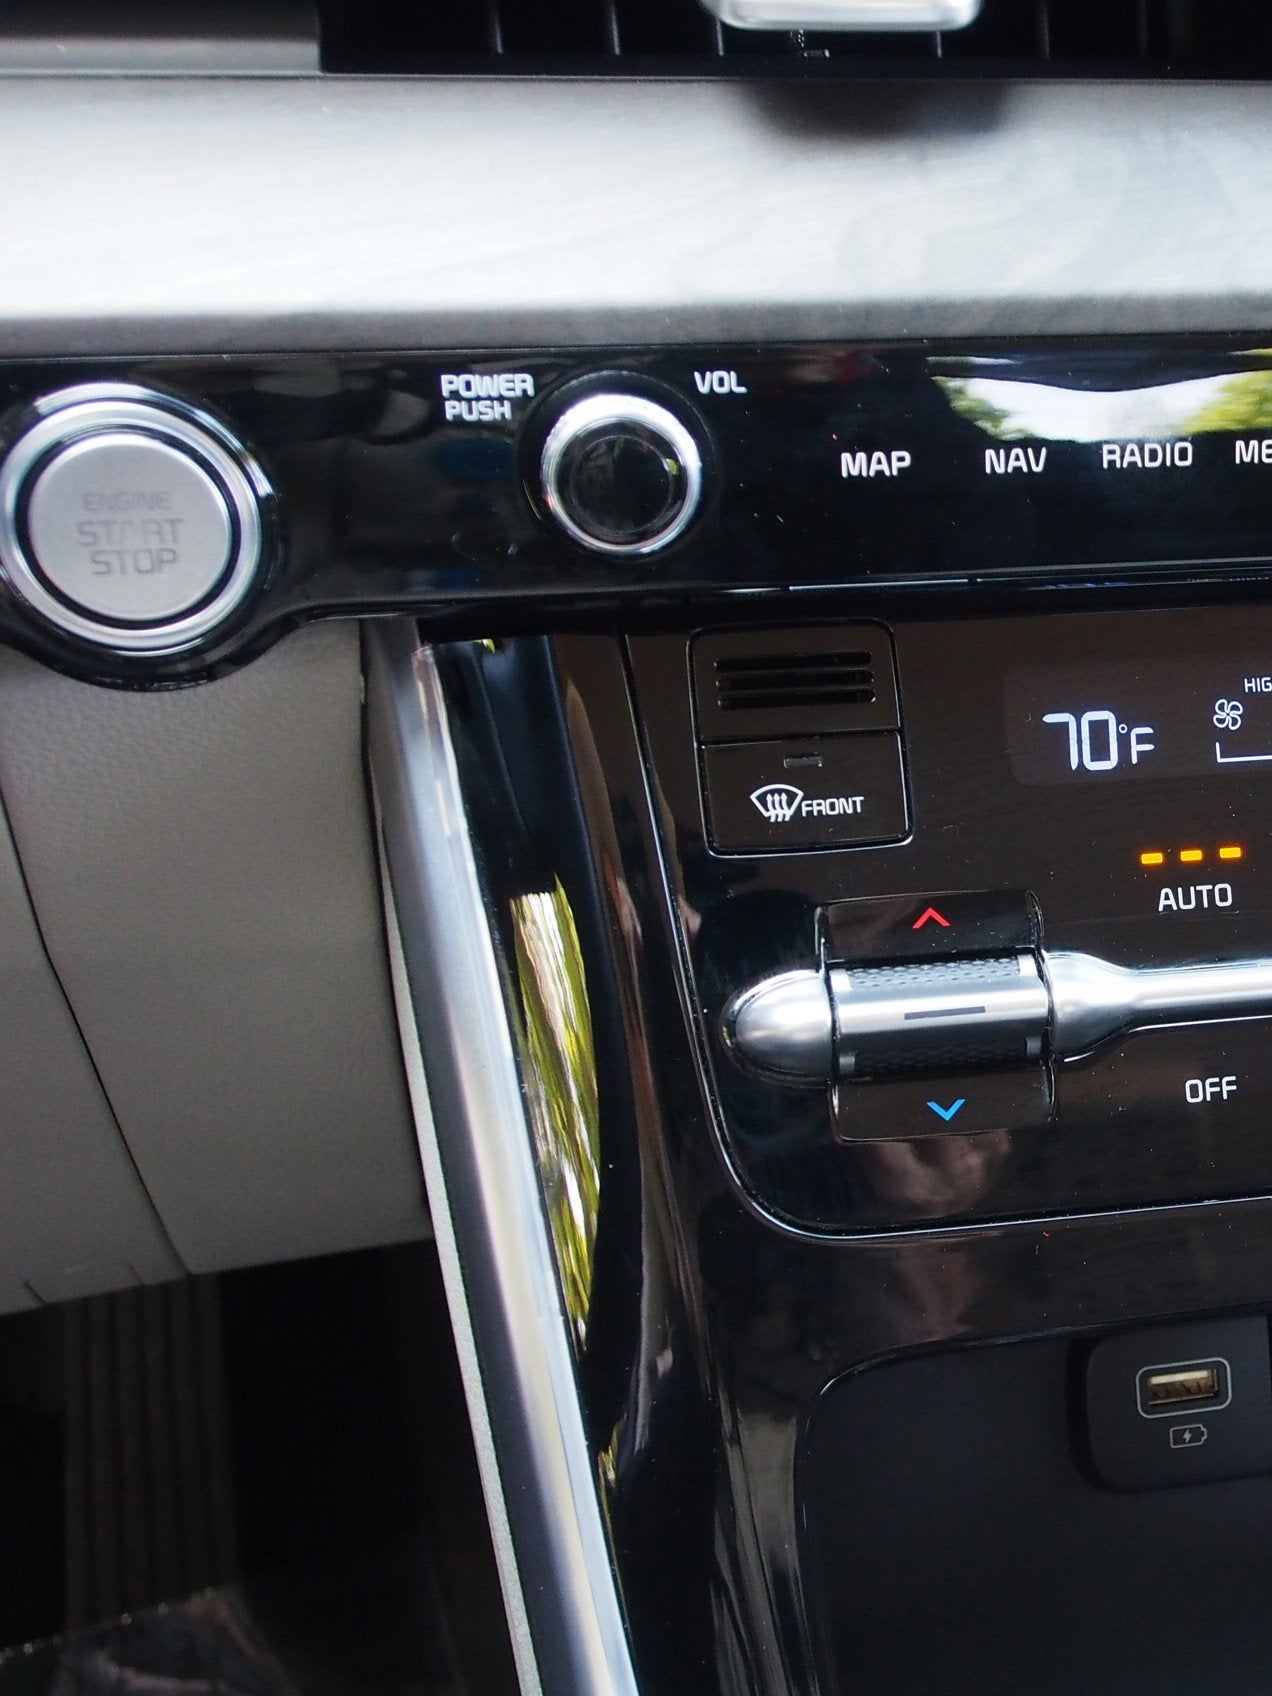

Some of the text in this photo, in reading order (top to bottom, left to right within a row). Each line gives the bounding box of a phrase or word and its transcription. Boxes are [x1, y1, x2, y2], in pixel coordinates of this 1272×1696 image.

[440, 373, 535, 399] POWER
[693, 370, 748, 395] VOL
[444, 399, 512, 422] PUSH
[840, 450, 911, 478] MAP
[984, 446, 1047, 474] NAV
[1101, 440, 1194, 469] RADIO
[89, 548, 179, 576] STOP
[801, 795, 865, 817] FRONT
[1158, 884, 1233, 913] AUTO
[1185, 1076, 1237, 1104] OFF
